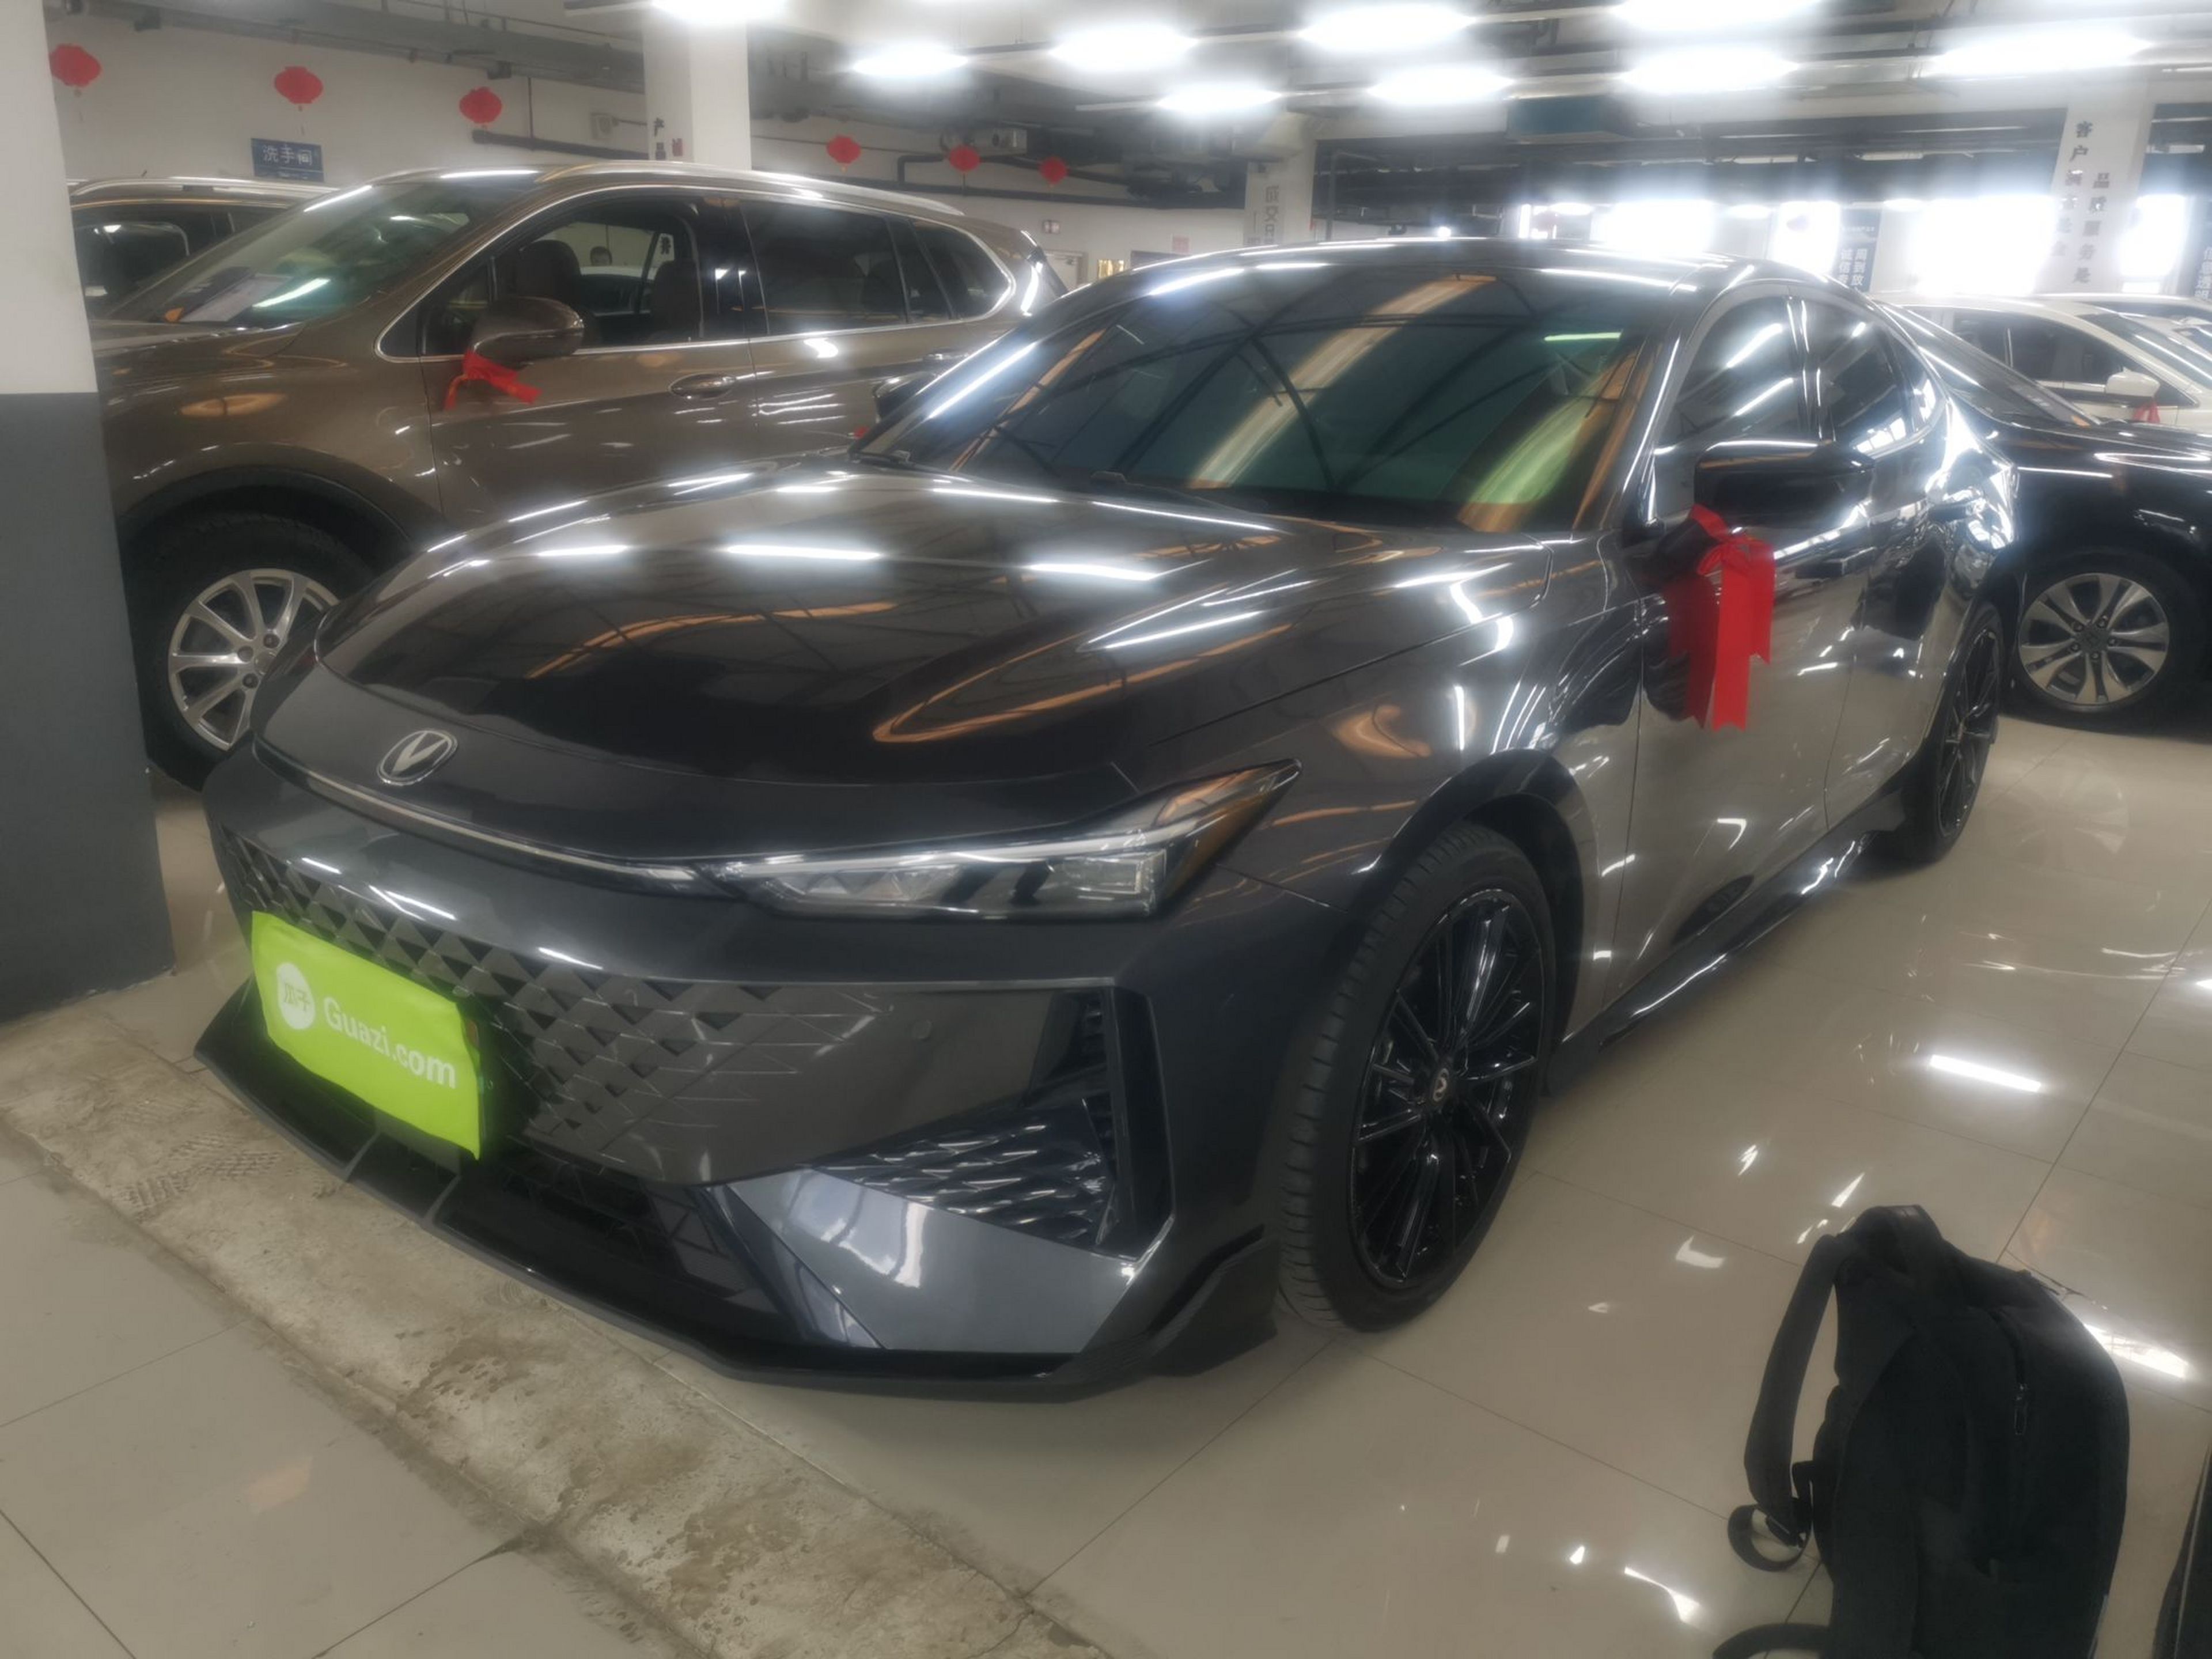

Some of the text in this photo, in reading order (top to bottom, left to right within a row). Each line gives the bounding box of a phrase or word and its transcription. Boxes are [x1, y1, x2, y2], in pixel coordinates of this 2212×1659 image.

[262, 143, 313, 166] 洗手间
[284, 982, 310, 1013] 瓜子
[324, 996, 456, 1089] Guazi.com
